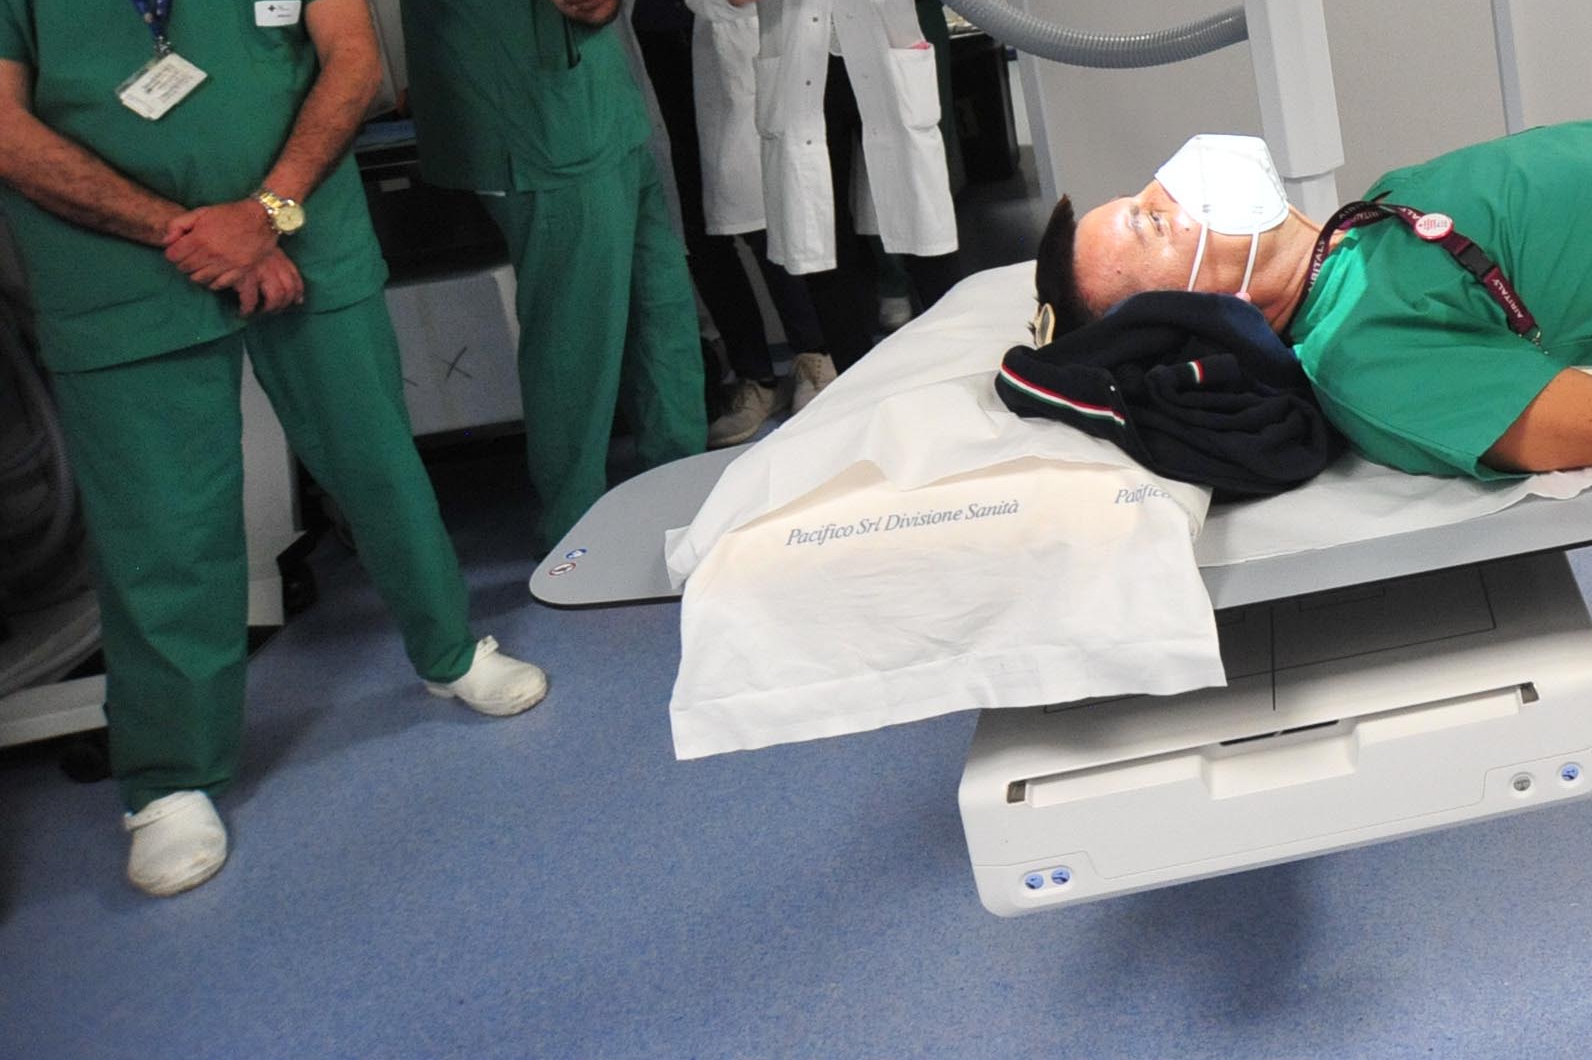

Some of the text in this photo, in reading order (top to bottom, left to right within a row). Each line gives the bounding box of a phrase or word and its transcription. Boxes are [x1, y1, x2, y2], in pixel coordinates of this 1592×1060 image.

[1491, 279, 1524, 318] AIRITALY
[786, 499, 1020, 546] Pacifico Srl Divisione Sanità
